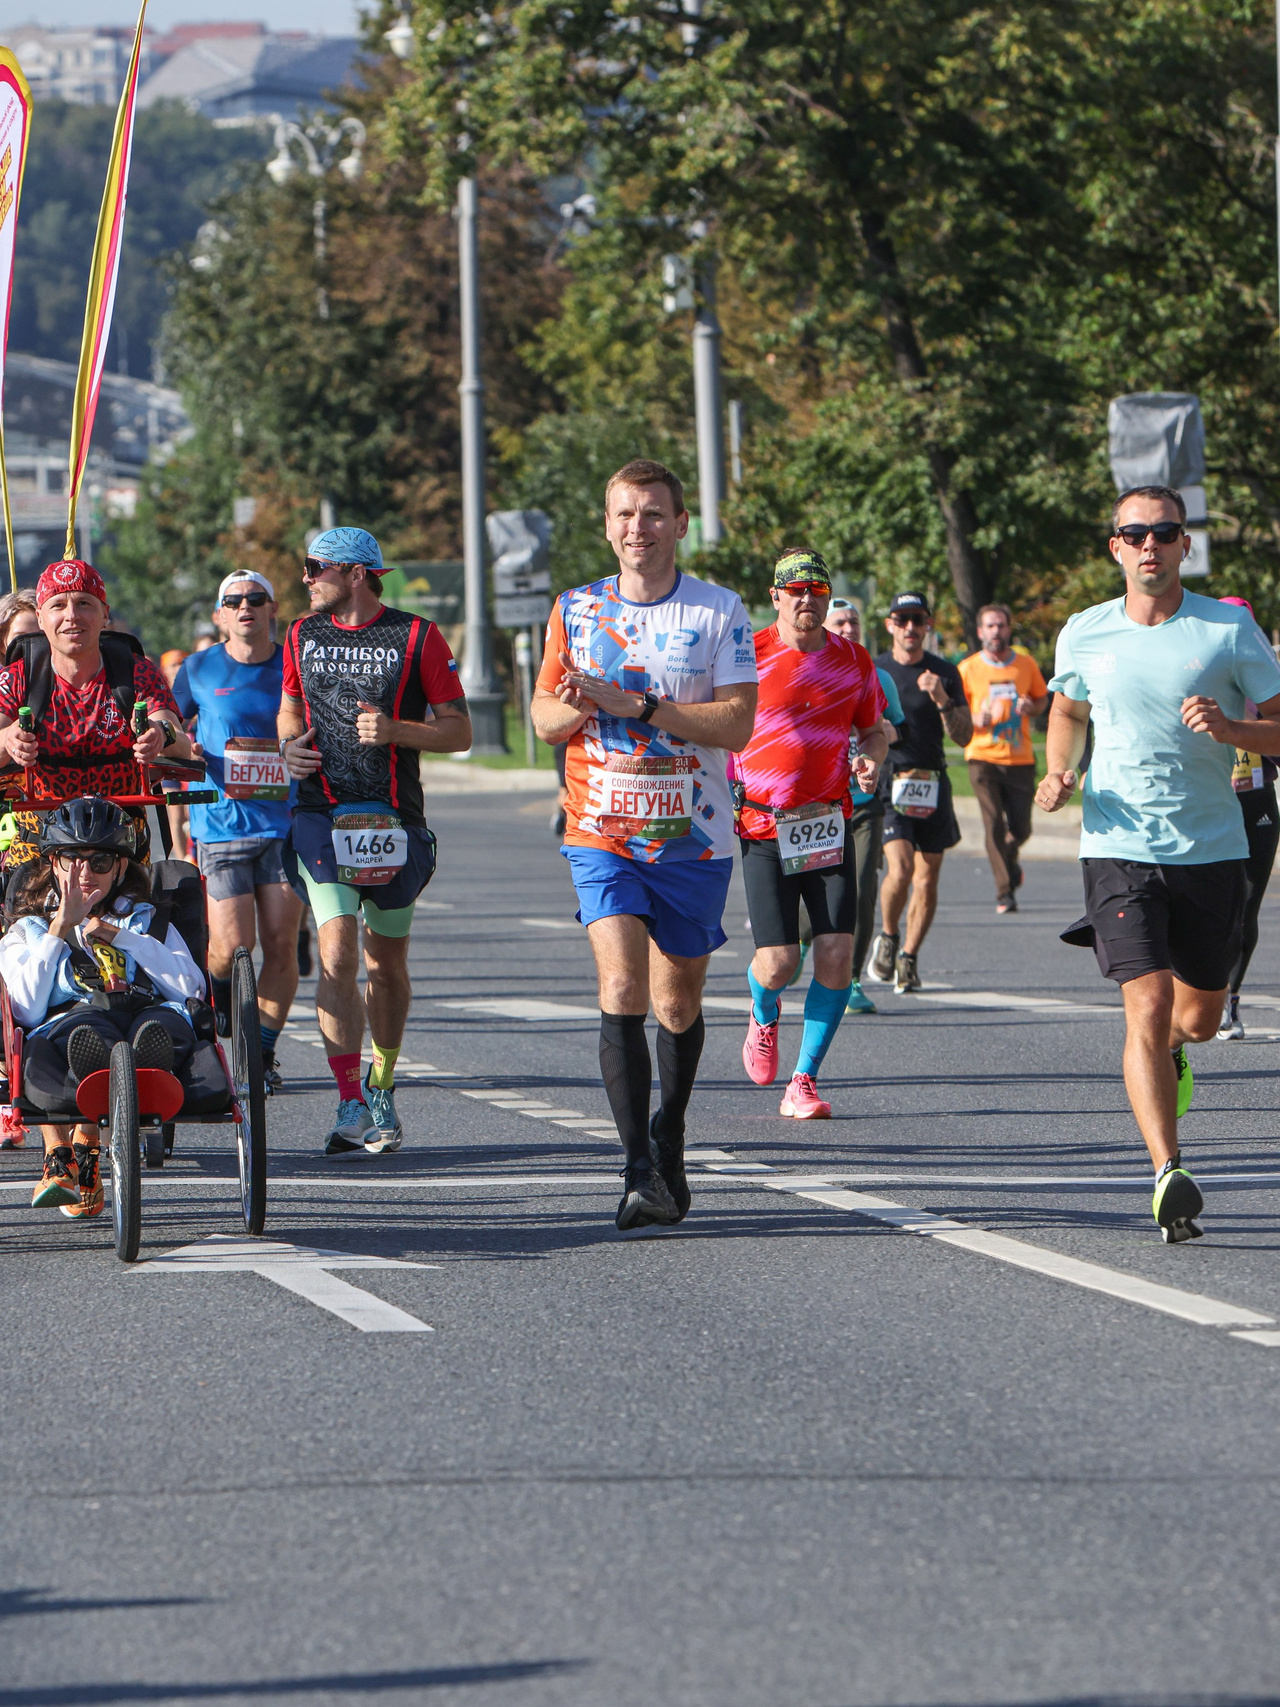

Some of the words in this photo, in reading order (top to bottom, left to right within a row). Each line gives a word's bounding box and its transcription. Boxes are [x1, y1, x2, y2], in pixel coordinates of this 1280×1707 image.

[667, 655, 690, 663] Boris
[665, 665, 707, 676] Vartanyan
[231, 754, 285, 764] СОПРОВОЖДЕНИЕ
[230, 764, 285, 784] БЕГУНА
[611, 778, 685, 791] СОПРОВОЖДЕНИЕ
[901, 784, 931, 798] 7347
[610, 790, 685, 816] БЕГУНА
[789, 819, 839, 845] 6926
[344, 834, 396, 855] 1466
[797, 839, 835, 852] АЛЕКСАНДР
[355, 856, 383, 864] АНДРЕЙ
[791, 857, 799, 869] F
